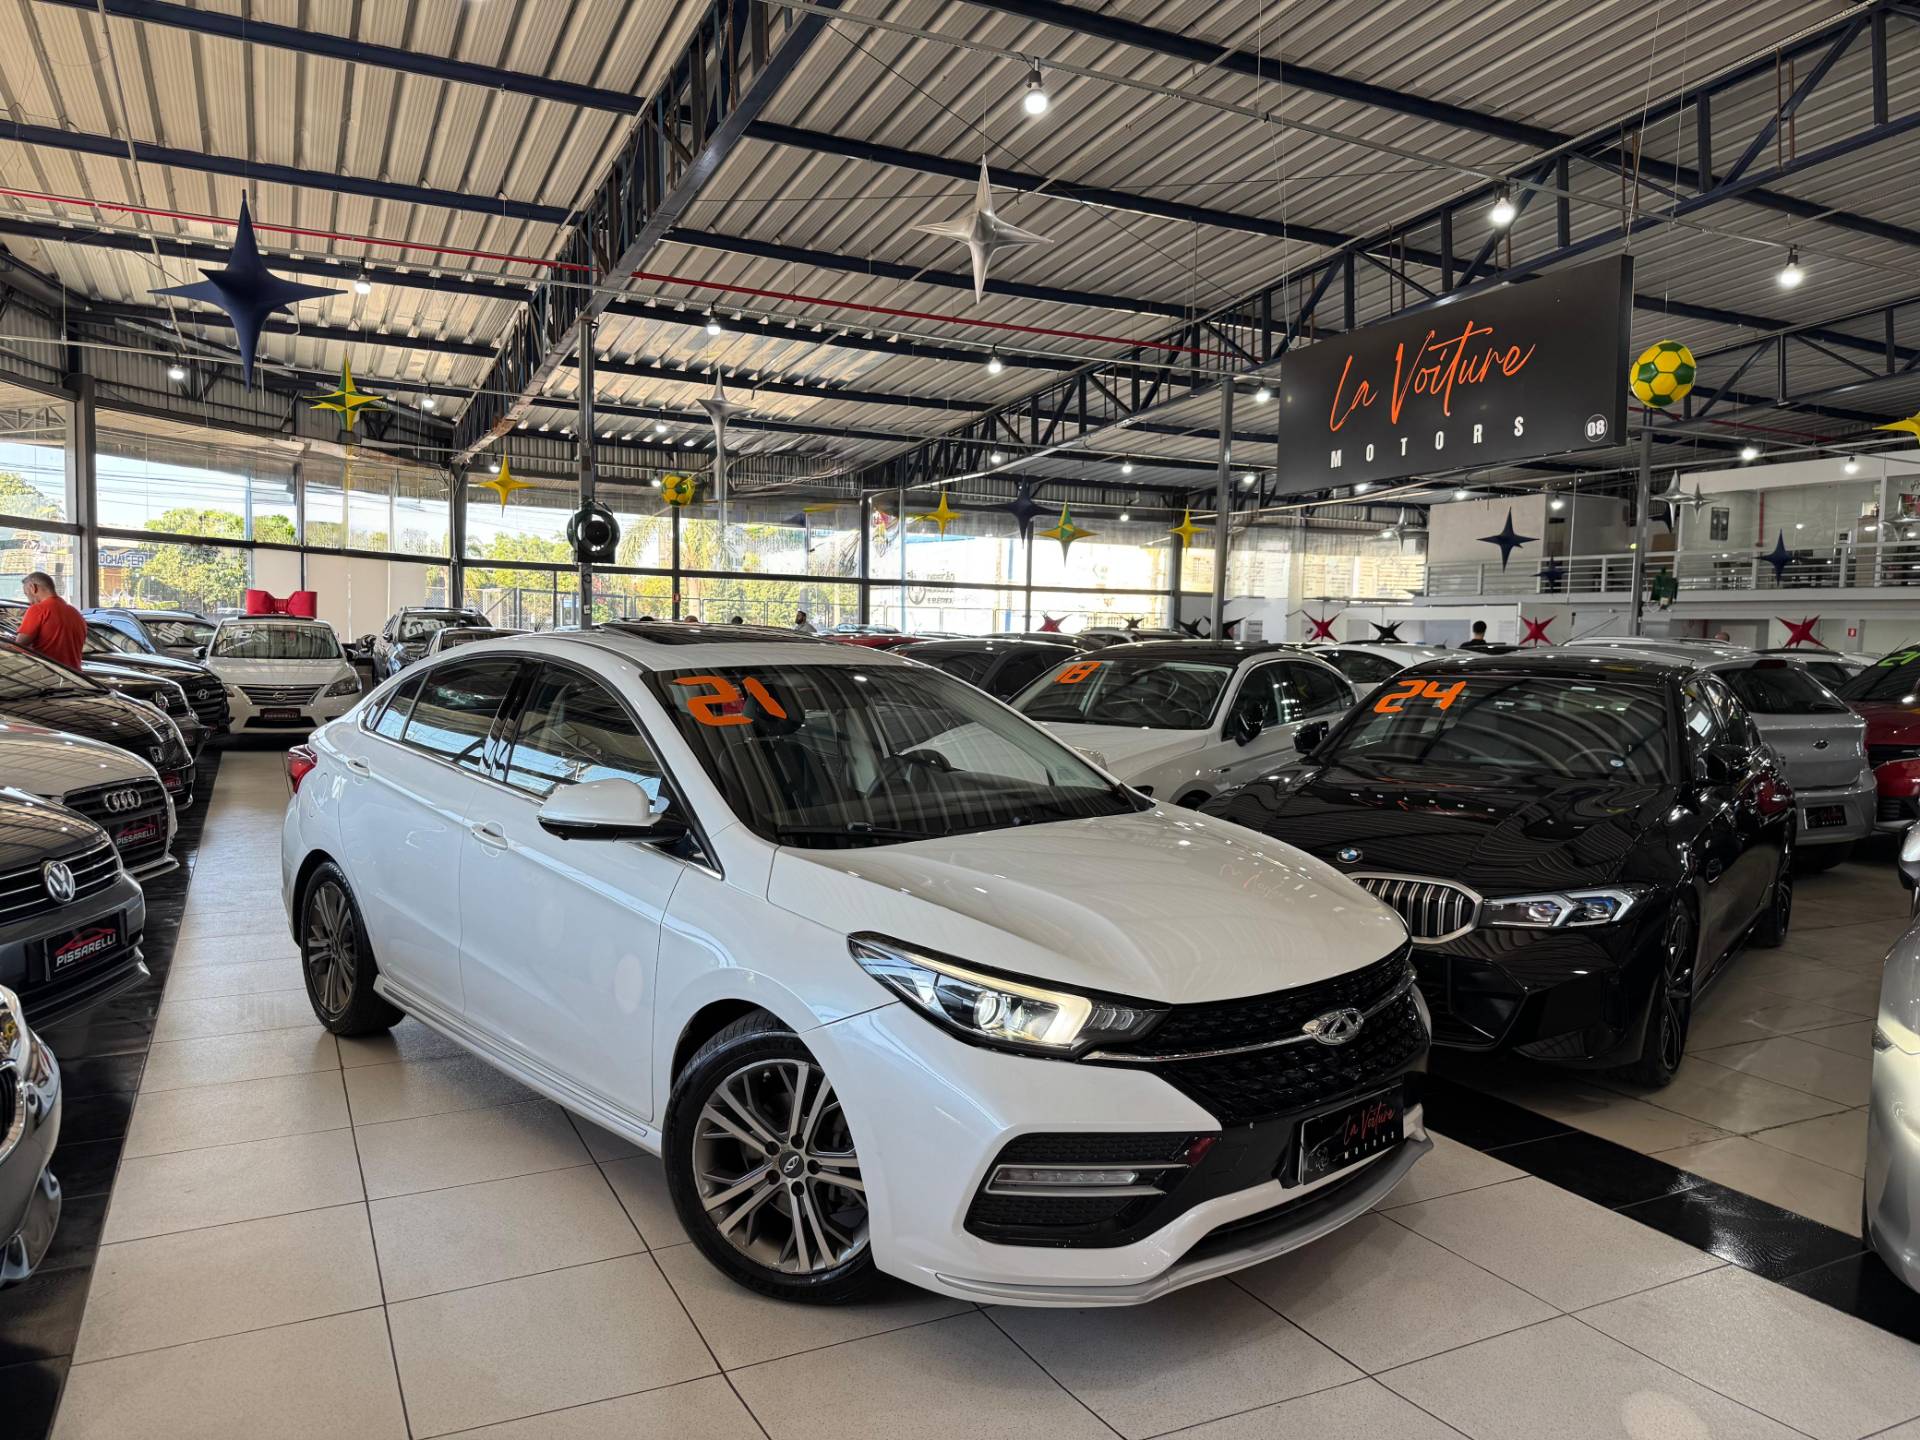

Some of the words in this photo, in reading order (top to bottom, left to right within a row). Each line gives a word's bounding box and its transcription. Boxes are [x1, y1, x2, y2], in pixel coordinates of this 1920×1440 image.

[1329, 355, 1378, 432] La
[1391, 320, 1537, 425] Voiture
[1330, 416, 1524, 469] MOTORS
[1586, 419, 1606, 437] 08
[1054, 661, 1104, 684] 18
[672, 675, 787, 727] 21
[1373, 679, 1467, 713] 24
[116, 827, 156, 847] PISSARELLI
[56, 932, 116, 967] PISSARELLI
[1344, 1130, 1395, 1160] MOTORS
